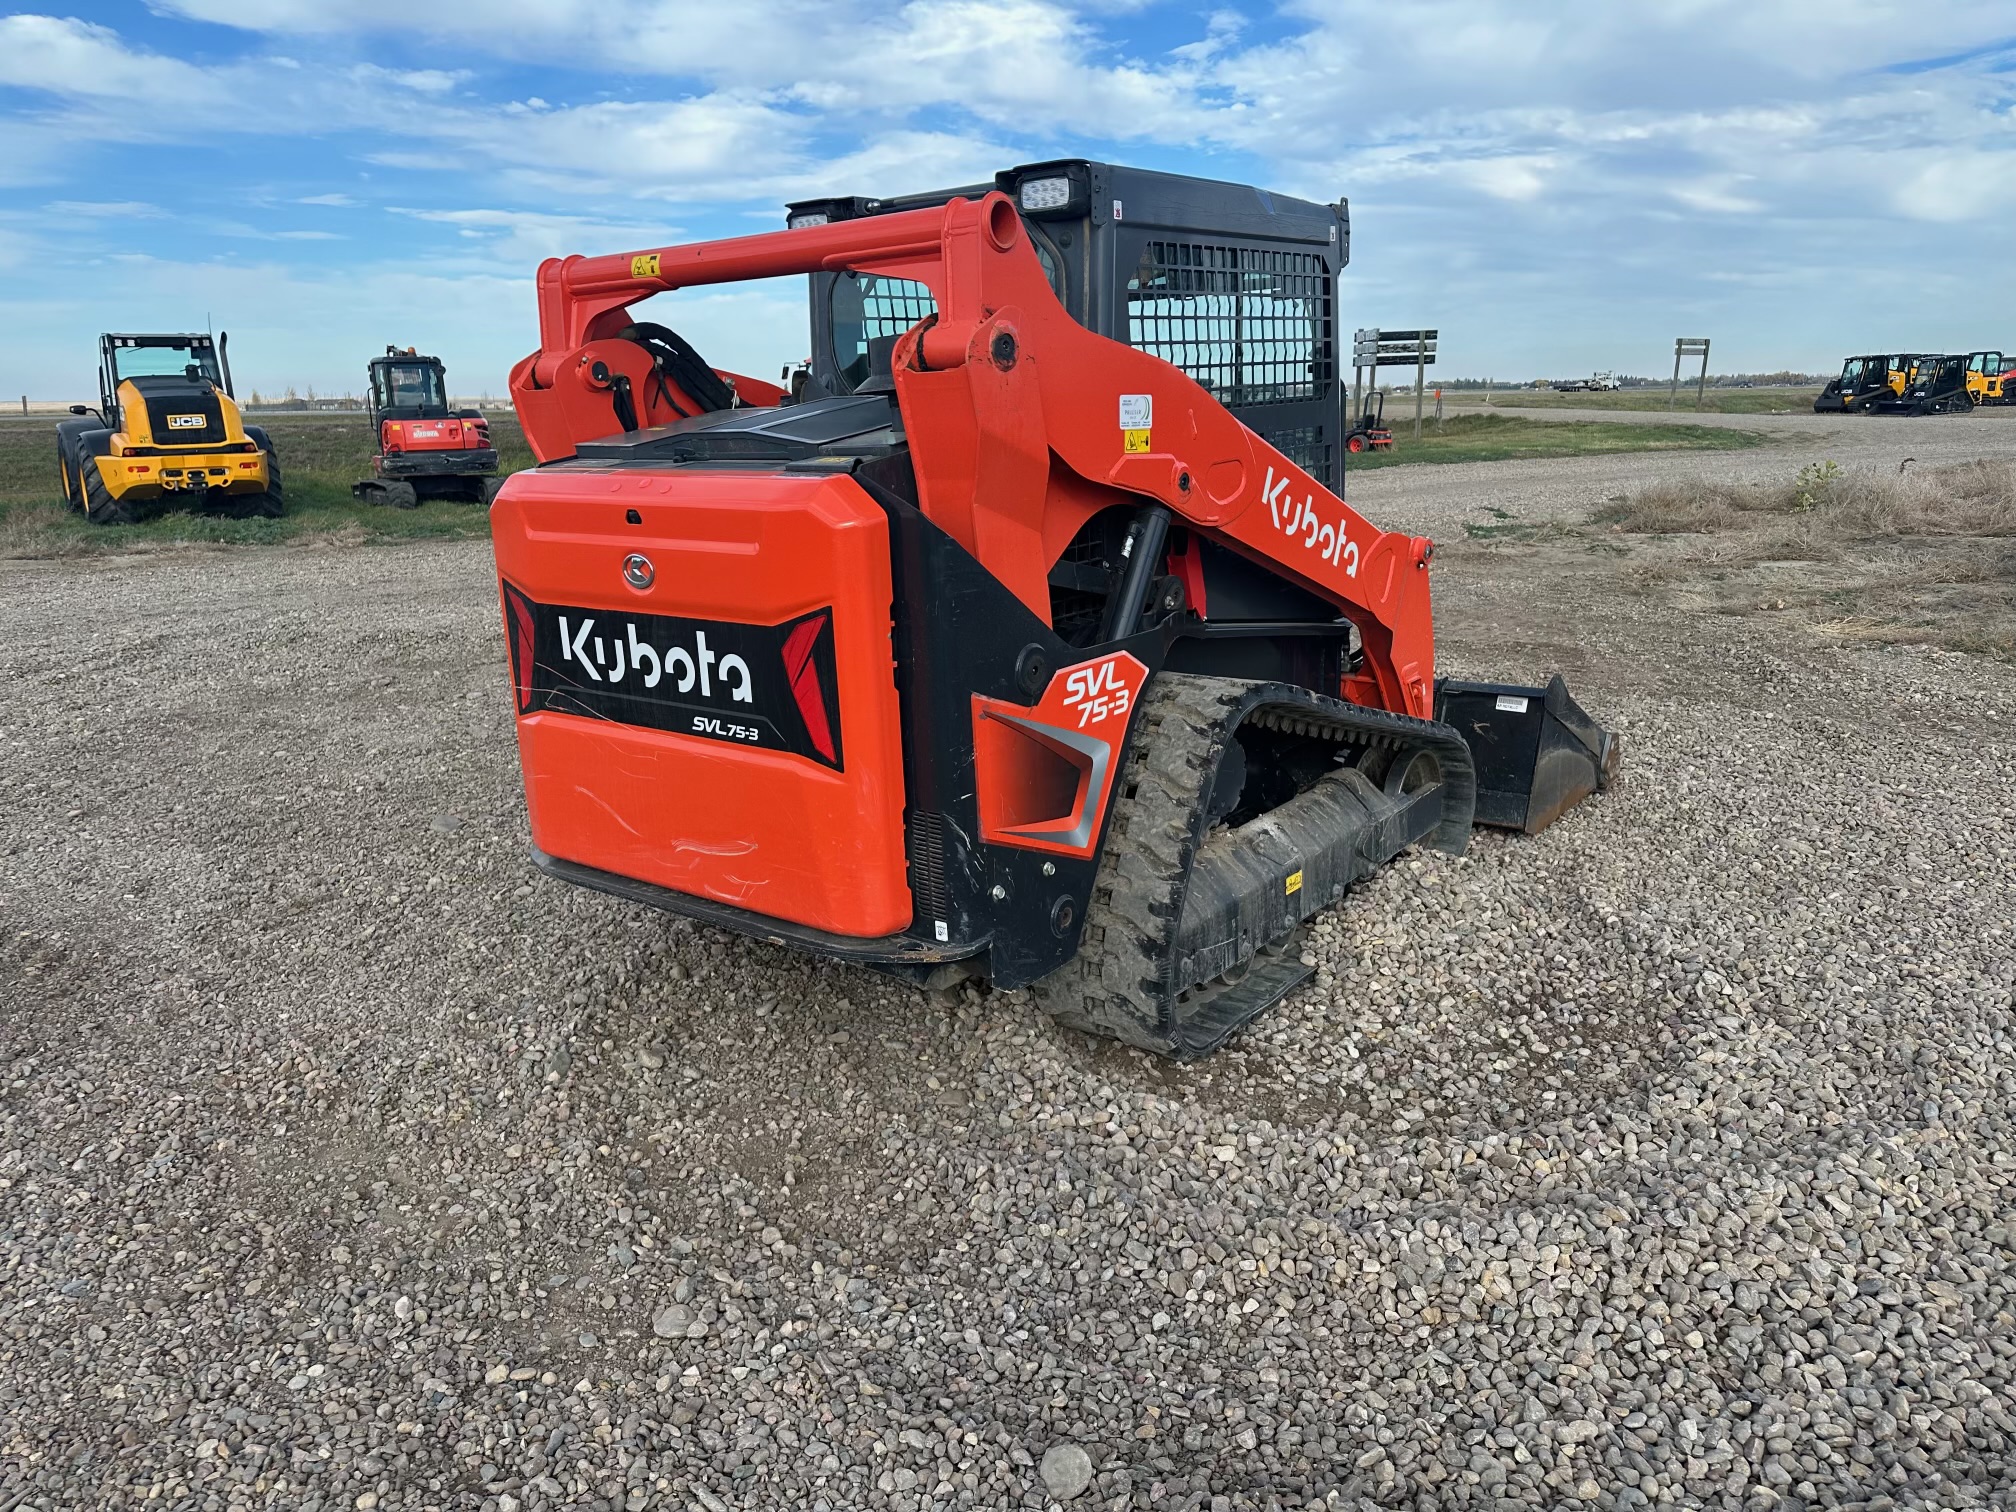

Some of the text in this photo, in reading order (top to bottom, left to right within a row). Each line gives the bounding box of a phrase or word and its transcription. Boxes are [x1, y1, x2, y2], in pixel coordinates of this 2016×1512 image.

[170, 416, 204, 427] JCB
[1261, 465, 1359, 579] Kubota
[558, 615, 753, 704] Kubota
[1062, 660, 1126, 707] SVL
[1077, 688, 1130, 729] 75-3
